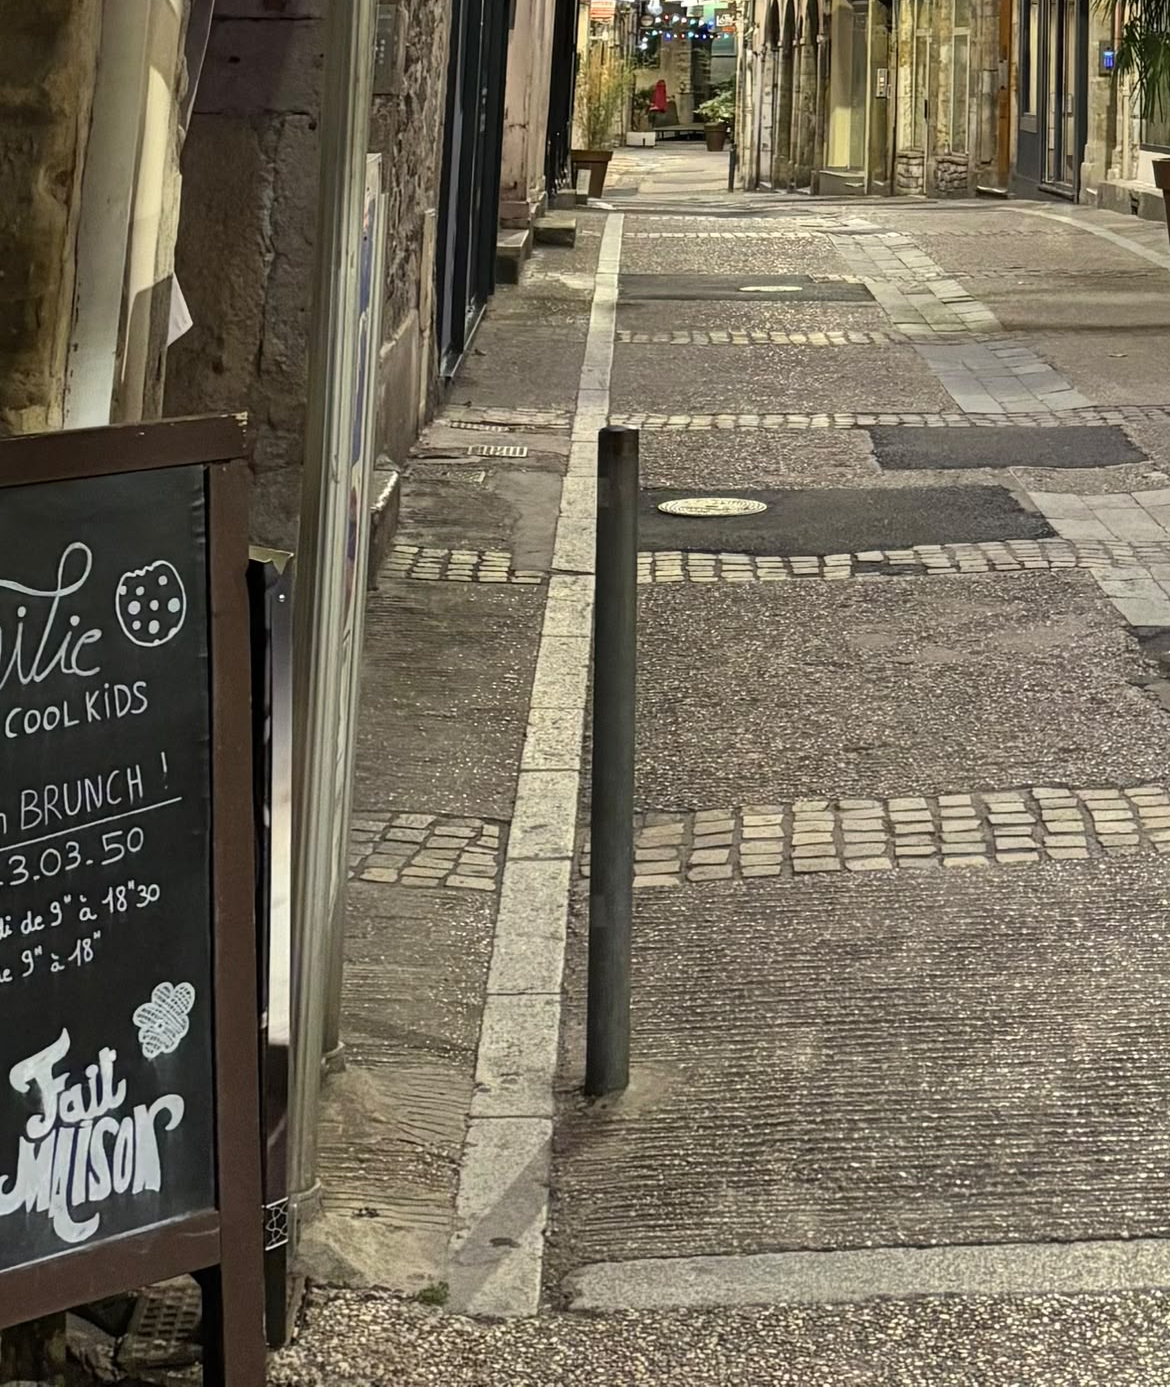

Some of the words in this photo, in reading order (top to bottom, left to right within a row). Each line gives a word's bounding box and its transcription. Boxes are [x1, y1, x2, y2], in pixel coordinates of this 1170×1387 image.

[0, 541, 102, 690] ilie
[5, 700, 80, 738] COOL
[21, 764, 144, 830] BRUNCH
[0, 827, 145, 886] 3.03.50
[21, 911, 45, 934] de
[79, 894, 98, 921] à
[50, 952, 65, 972] à
[9, 1027, 127, 1139] Fait
